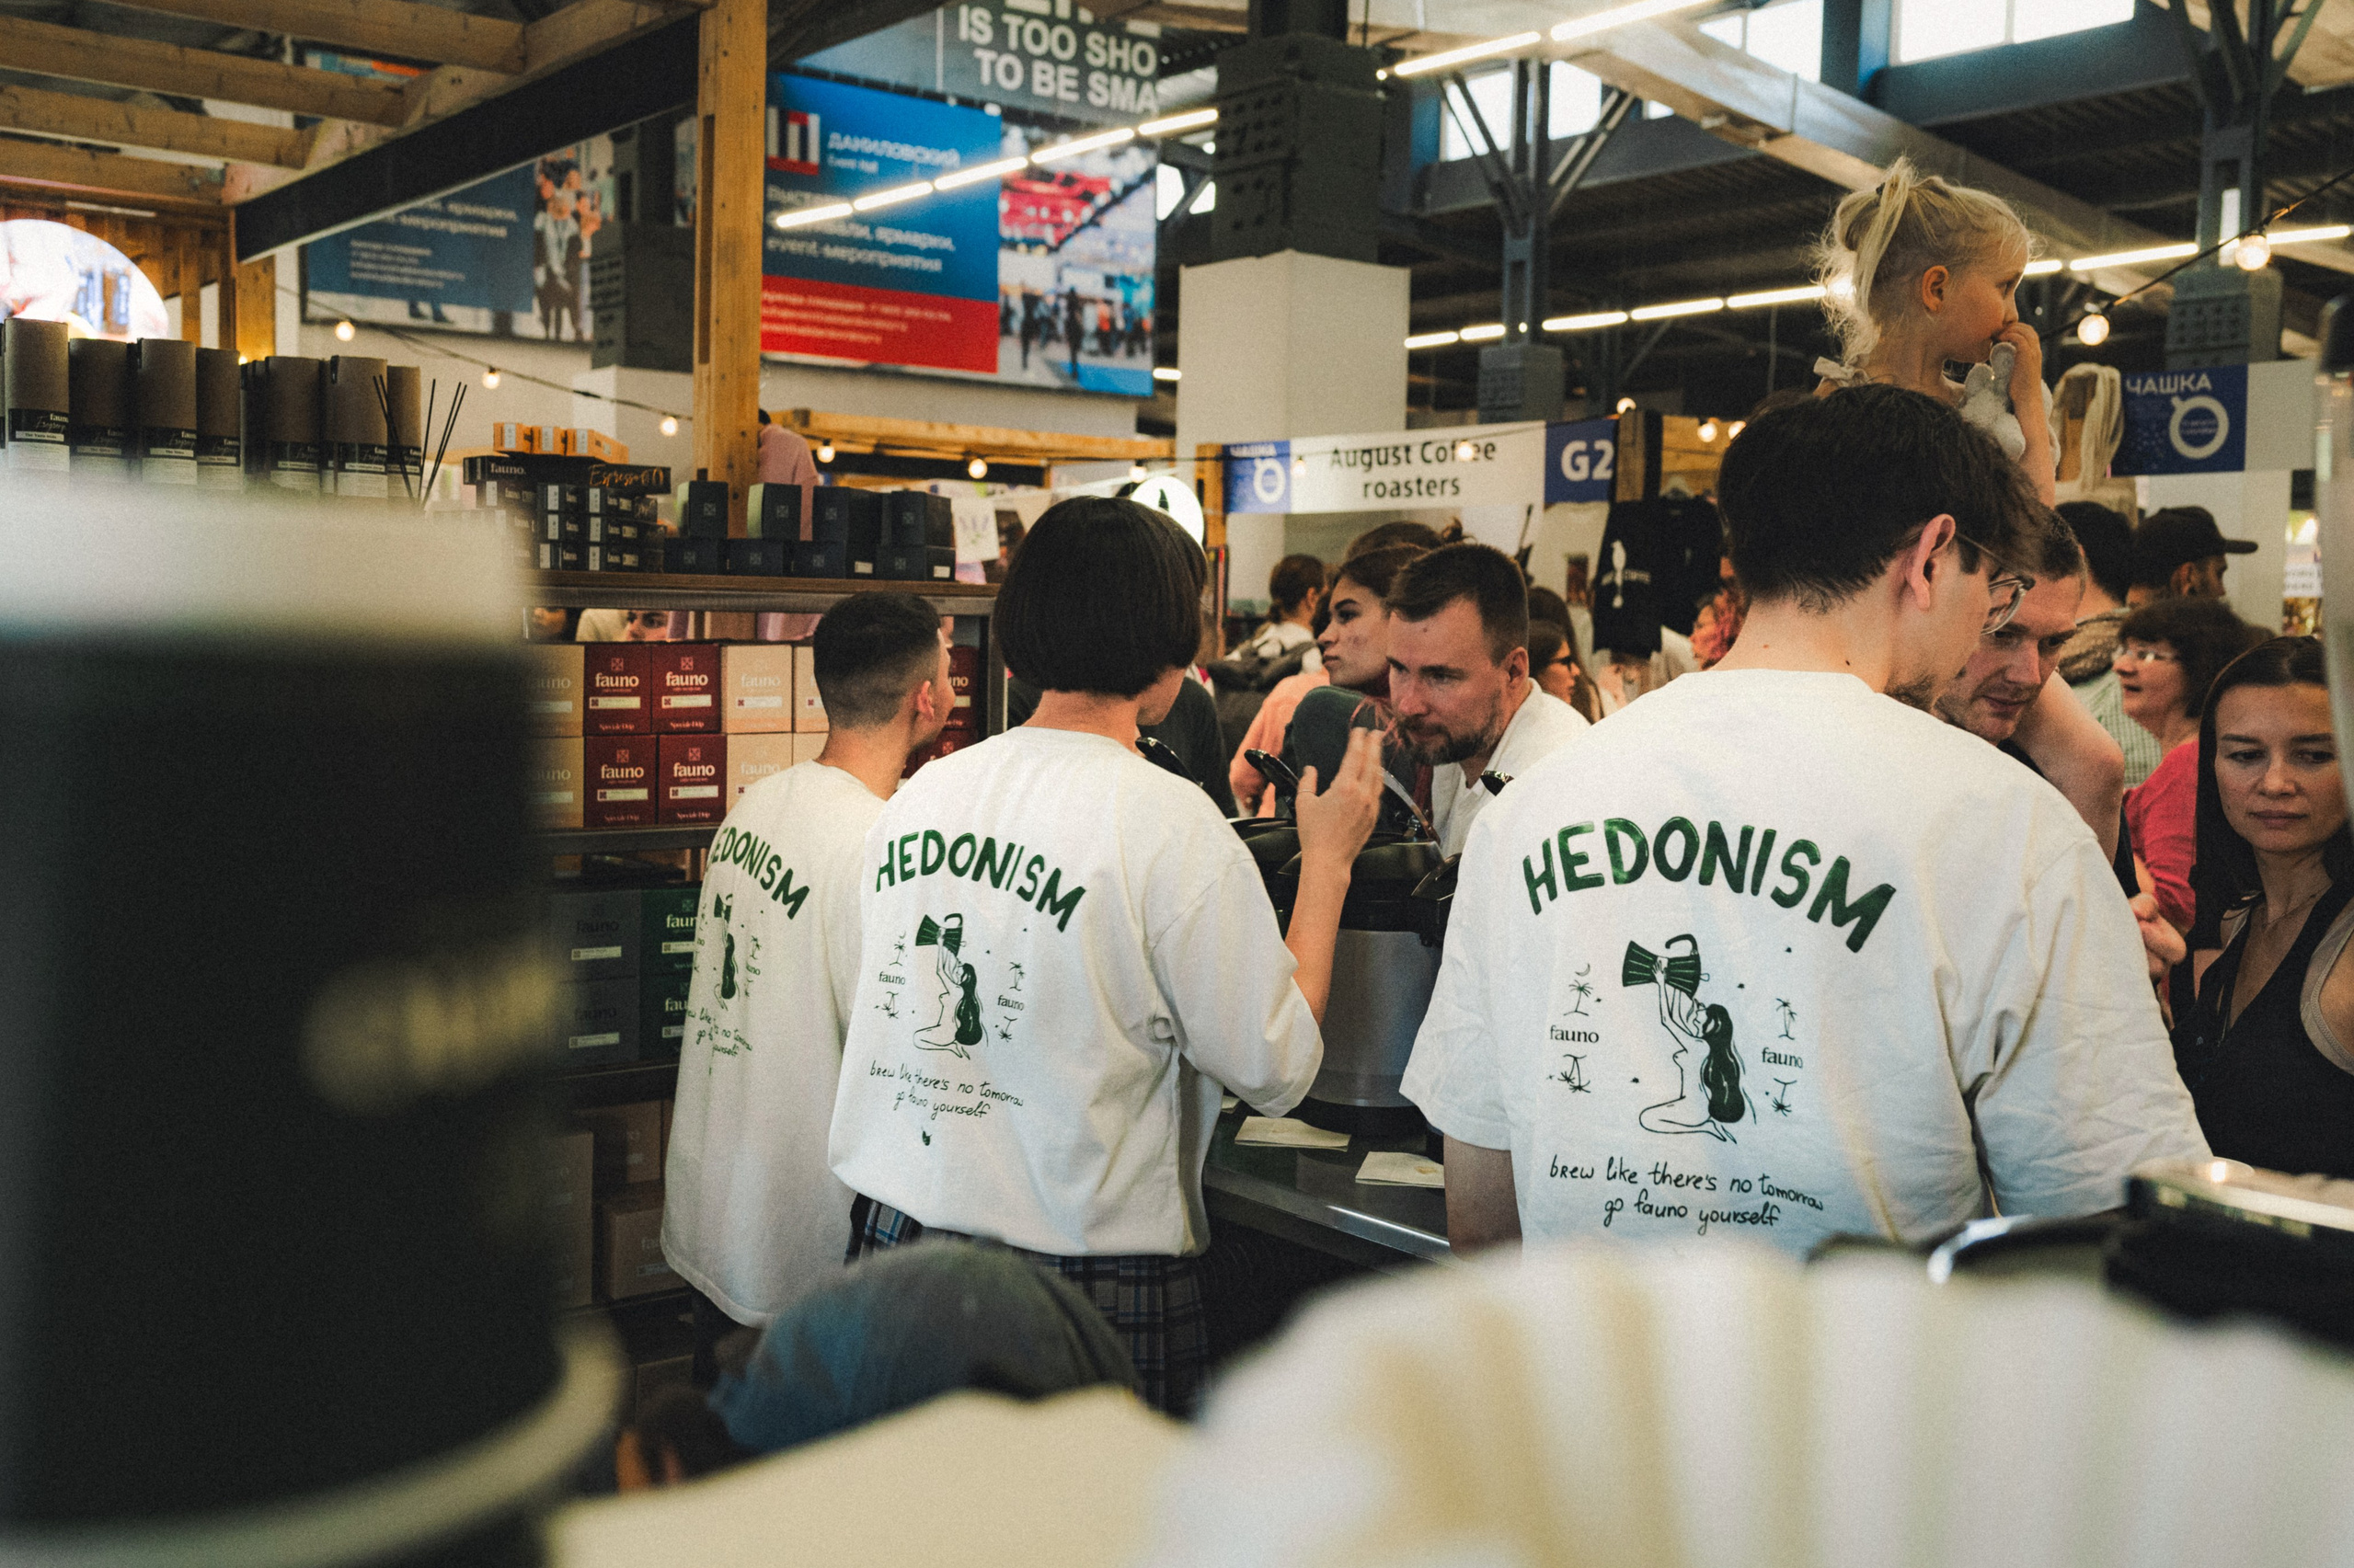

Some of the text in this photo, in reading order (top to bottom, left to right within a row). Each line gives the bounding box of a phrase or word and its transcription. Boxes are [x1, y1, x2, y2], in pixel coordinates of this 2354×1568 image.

[959, 4, 993, 45] IS
[1001, 13, 1077, 61] TOO
[973, 48, 1024, 90] TO
[1031, 59, 1080, 103] BE
[2126, 372, 2212, 395] ЧАШКА
[1330, 440, 1497, 473] August Cofee
[1560, 440, 1614, 482] G2
[1363, 475, 1461, 499] roasters
[595, 672, 639, 688] fauno
[666, 671, 708, 687] fauno
[741, 673, 781, 688] fauno
[601, 764, 644, 779] fauno
[673, 762, 715, 777] fauno
[876, 830, 1086, 933] HEDONISM
[1522, 816, 1897, 954] HEDONISM
[878, 971, 906, 986] fauno
[997, 995, 1024, 1012] fauno
[1550, 1024, 1600, 1044] fauno
[1762, 1047, 1803, 1069] fauno
[914, 1069, 950, 1091] there's
[958, 1082, 973, 1094] no
[980, 1081, 1024, 1107] tomorrow
[931, 1101, 991, 1120] yourself
[1550, 1154, 1824, 1211] brew like there's no tomorrow
[1604, 1188, 1781, 1236] go fauno yourself
